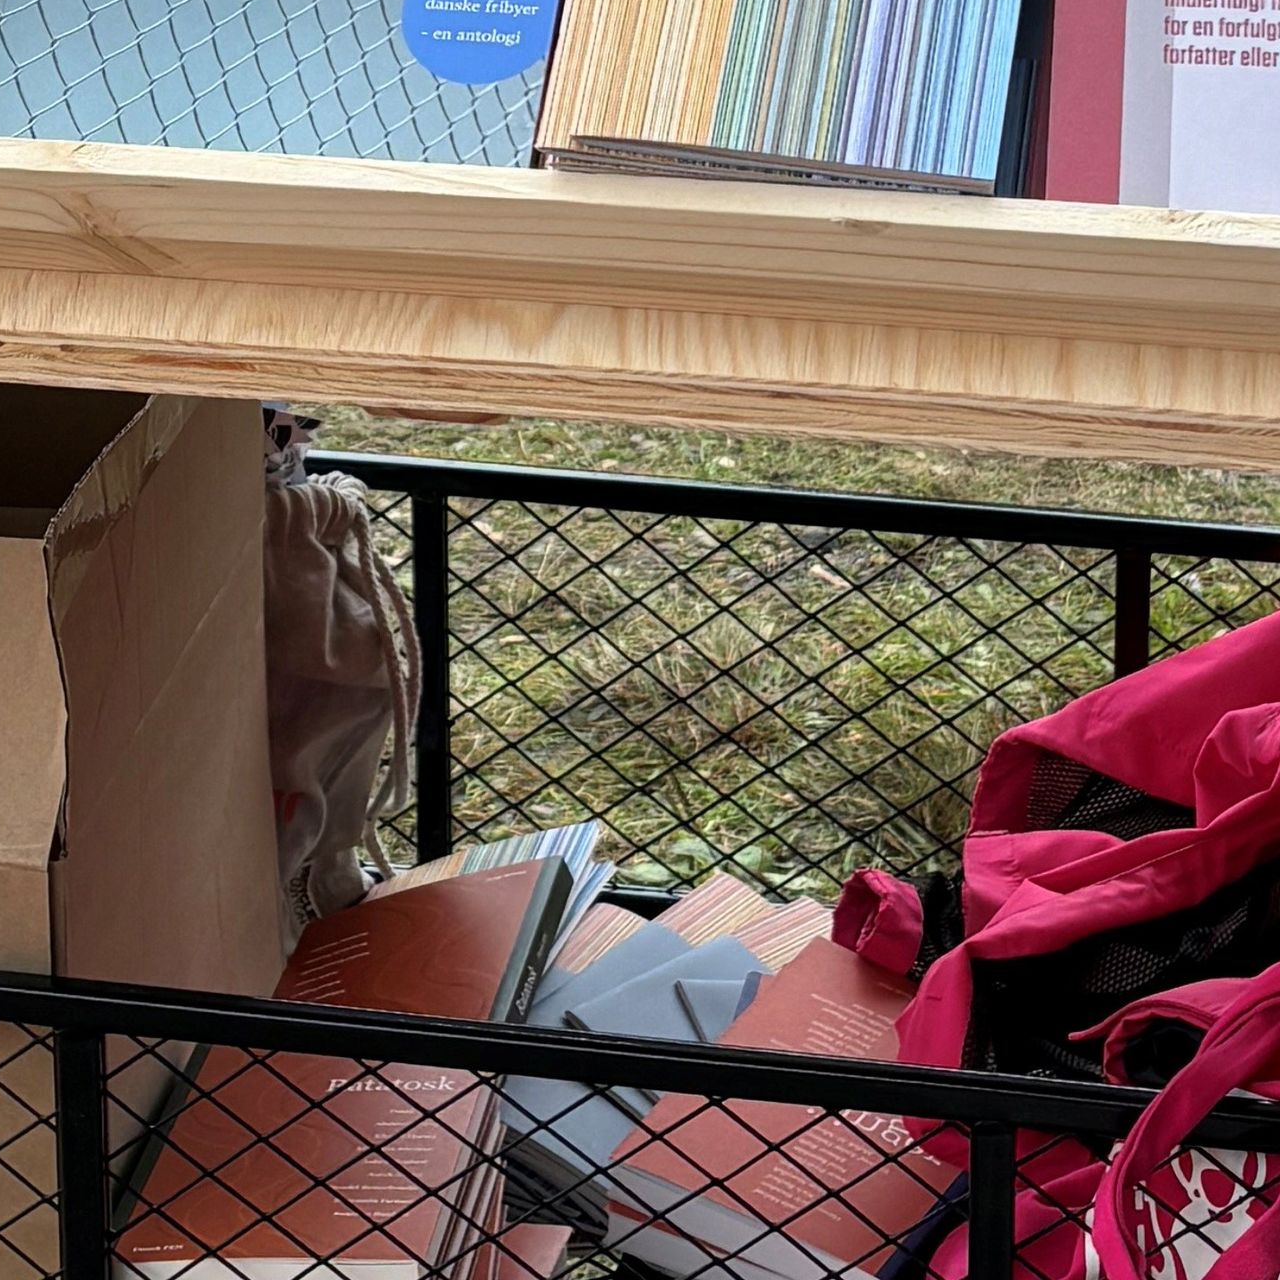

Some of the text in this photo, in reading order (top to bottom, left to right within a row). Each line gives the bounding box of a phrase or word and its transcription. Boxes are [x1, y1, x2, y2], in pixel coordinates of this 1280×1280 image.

[485, 0, 540, 18] fribyer
[1164, 15, 1189, 36] for
[1192, 18, 1214, 37] en
[432, 30, 452, 41] en
[456, 28, 522, 47] antologi
[1163, 43, 1236, 66] forfatter
[1240, 46, 1280, 68] eller
